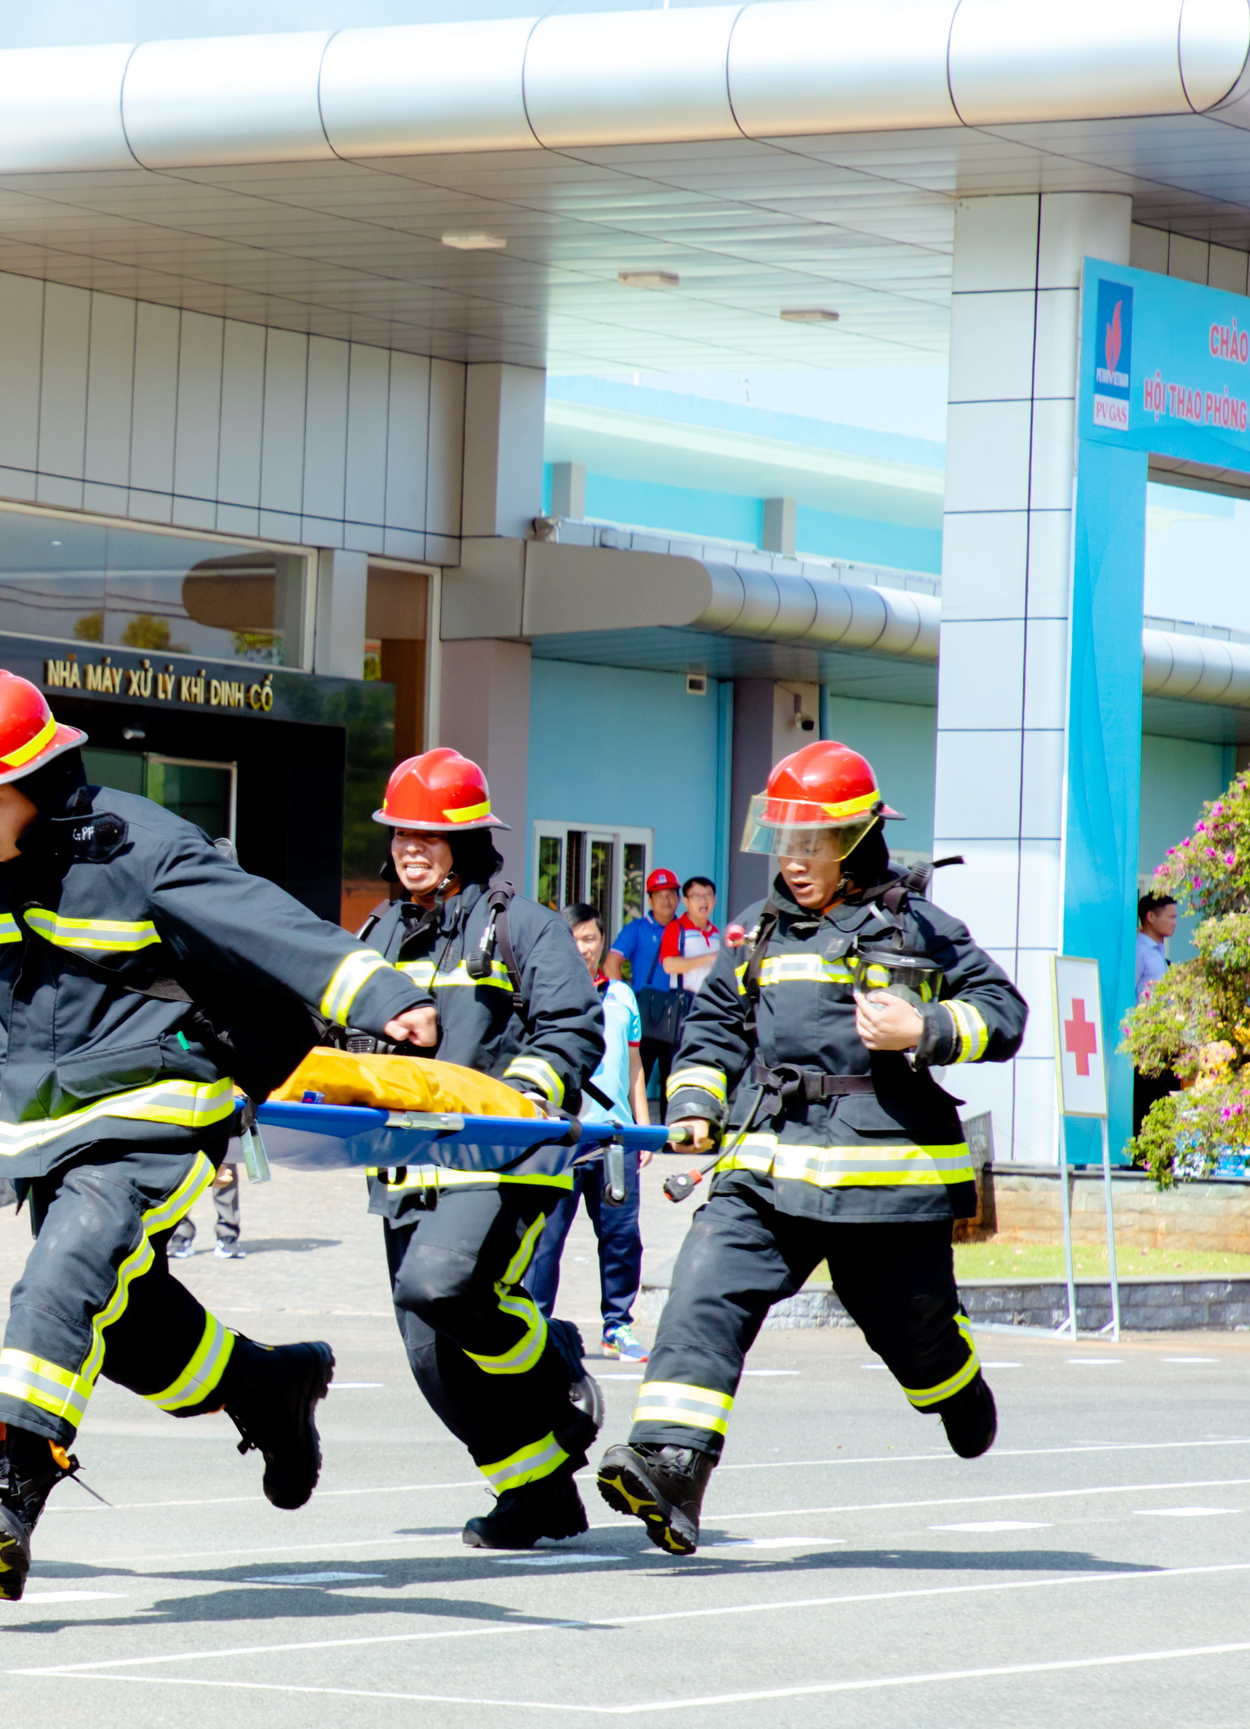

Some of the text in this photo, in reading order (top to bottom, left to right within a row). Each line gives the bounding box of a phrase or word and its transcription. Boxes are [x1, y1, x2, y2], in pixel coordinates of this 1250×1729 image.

[1210, 318, 1248, 363] CHÀO
[1096, 401, 1127, 423] PV GAS
[1144, 371, 1248, 431] HỘI THAO PHÒNG
[84, 657, 123, 694] MÁY
[157, 664, 176, 701] LÝ
[181, 669, 207, 704] KHÍ
[209, 679, 244, 708] DINH
[249, 673, 274, 712] CỐ
